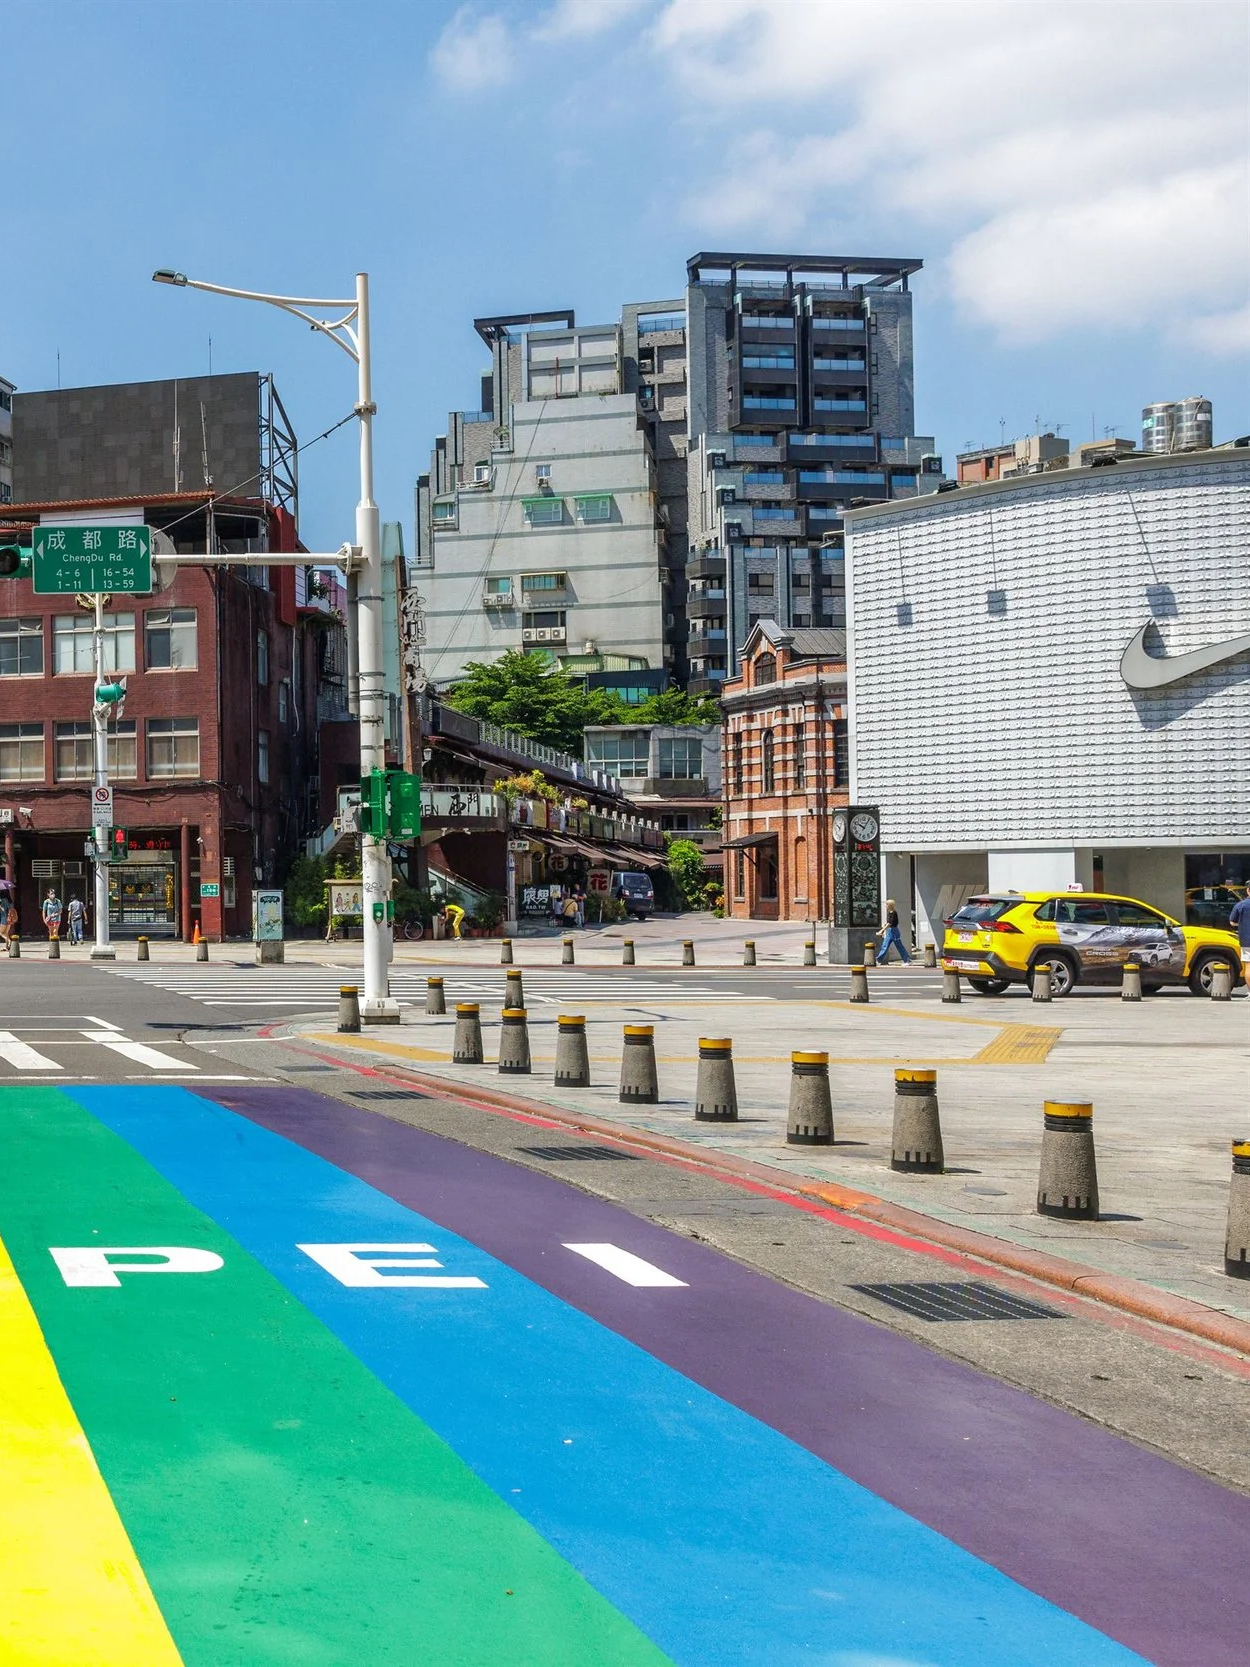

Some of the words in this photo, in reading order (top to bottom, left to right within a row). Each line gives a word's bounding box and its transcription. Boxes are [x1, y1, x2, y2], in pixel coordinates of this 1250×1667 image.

[47, 530, 137, 550] 成都路
[62, 553, 104, 564] ChengDu
[590, 873, 607, 891] 花
